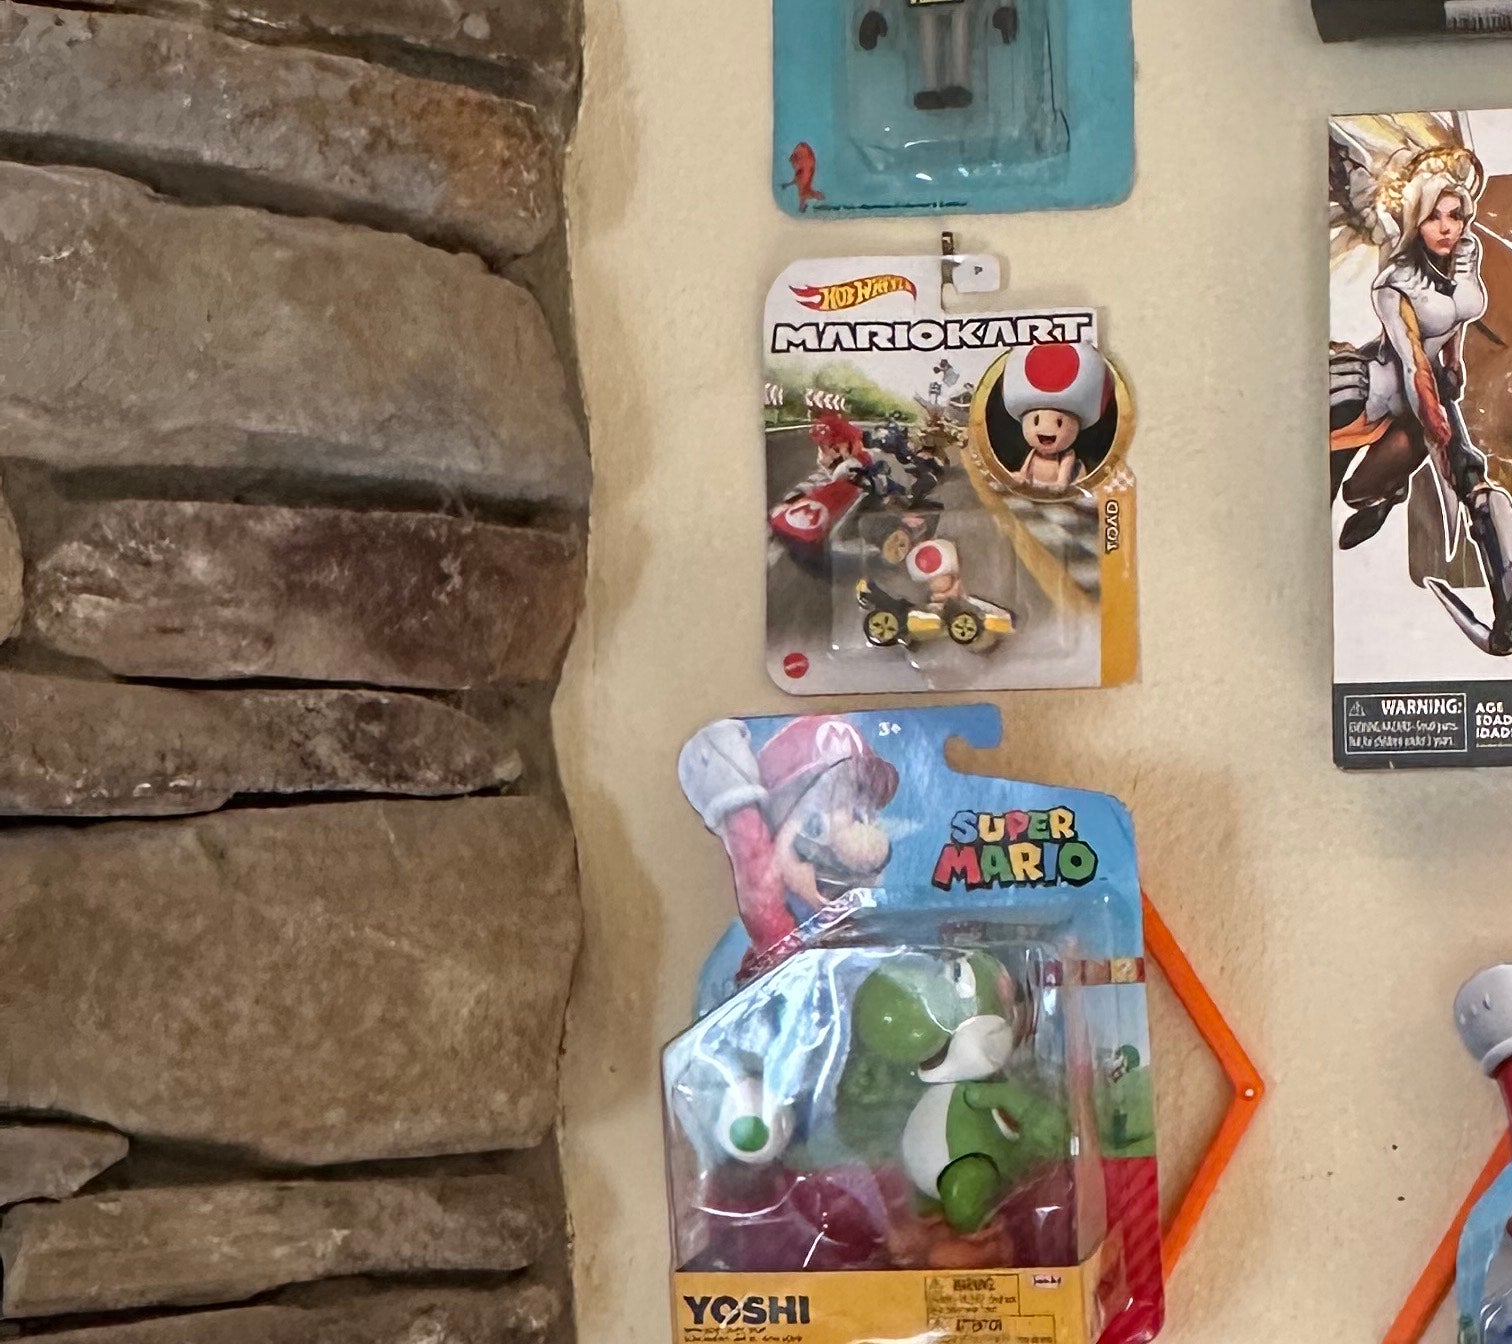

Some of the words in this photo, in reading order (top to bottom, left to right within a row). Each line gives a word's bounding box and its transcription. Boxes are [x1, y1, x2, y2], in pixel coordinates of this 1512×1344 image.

[1381, 698, 1463, 716] WARNING:
[950, 805, 1078, 845] SUPER
[931, 840, 1099, 892] MARIO
[683, 1294, 811, 1325] YOSHI
